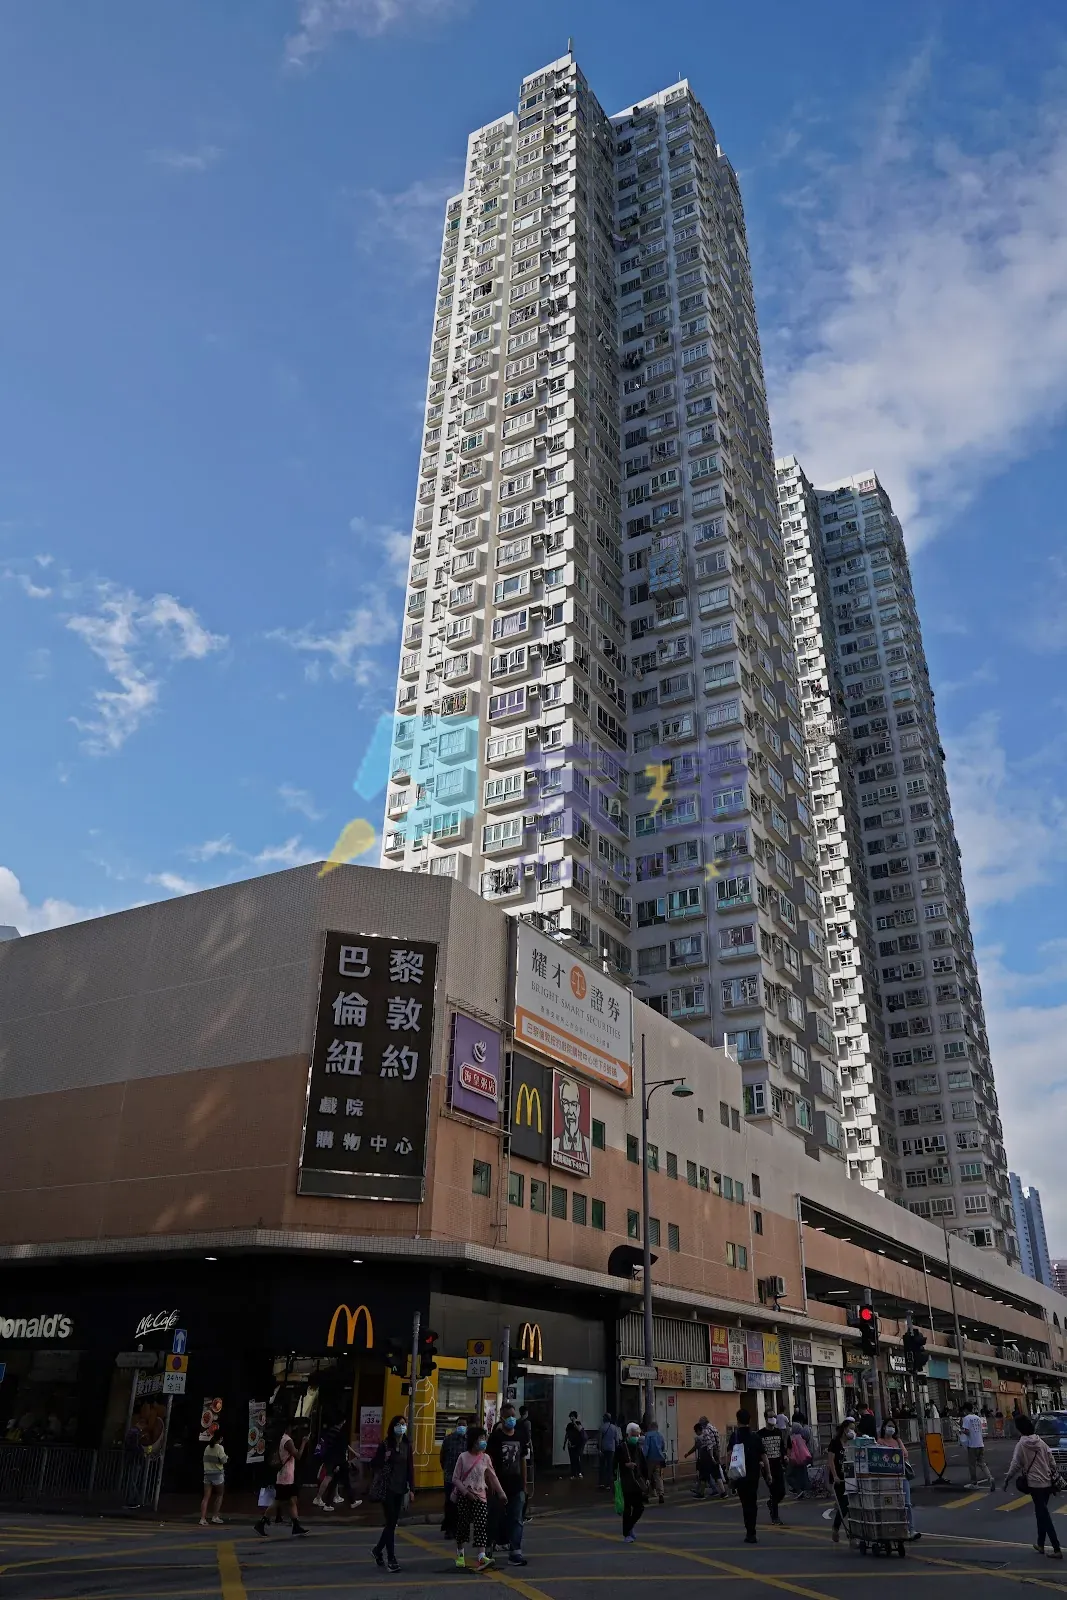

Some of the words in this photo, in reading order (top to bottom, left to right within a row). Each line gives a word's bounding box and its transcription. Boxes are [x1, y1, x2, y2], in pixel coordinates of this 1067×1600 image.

[338, 944, 425, 985] 巴黎
[531, 948, 567, 989] 耀才
[332, 990, 423, 1033] 倫敦
[531, 980, 560, 1005] BRIGHT
[561, 999, 585, 1021] SMART
[586, 1014, 621, 1040] SECURITIES
[324, 1038, 420, 1082] 紐約
[464, 1069, 495, 1093] 海皇粥店
[319, 1096, 364, 1118] 戲院
[315, 1130, 415, 1156] 購物中心
[167, 1382, 181, 1392] 全日
[471, 1366, 486, 1375] 全日
